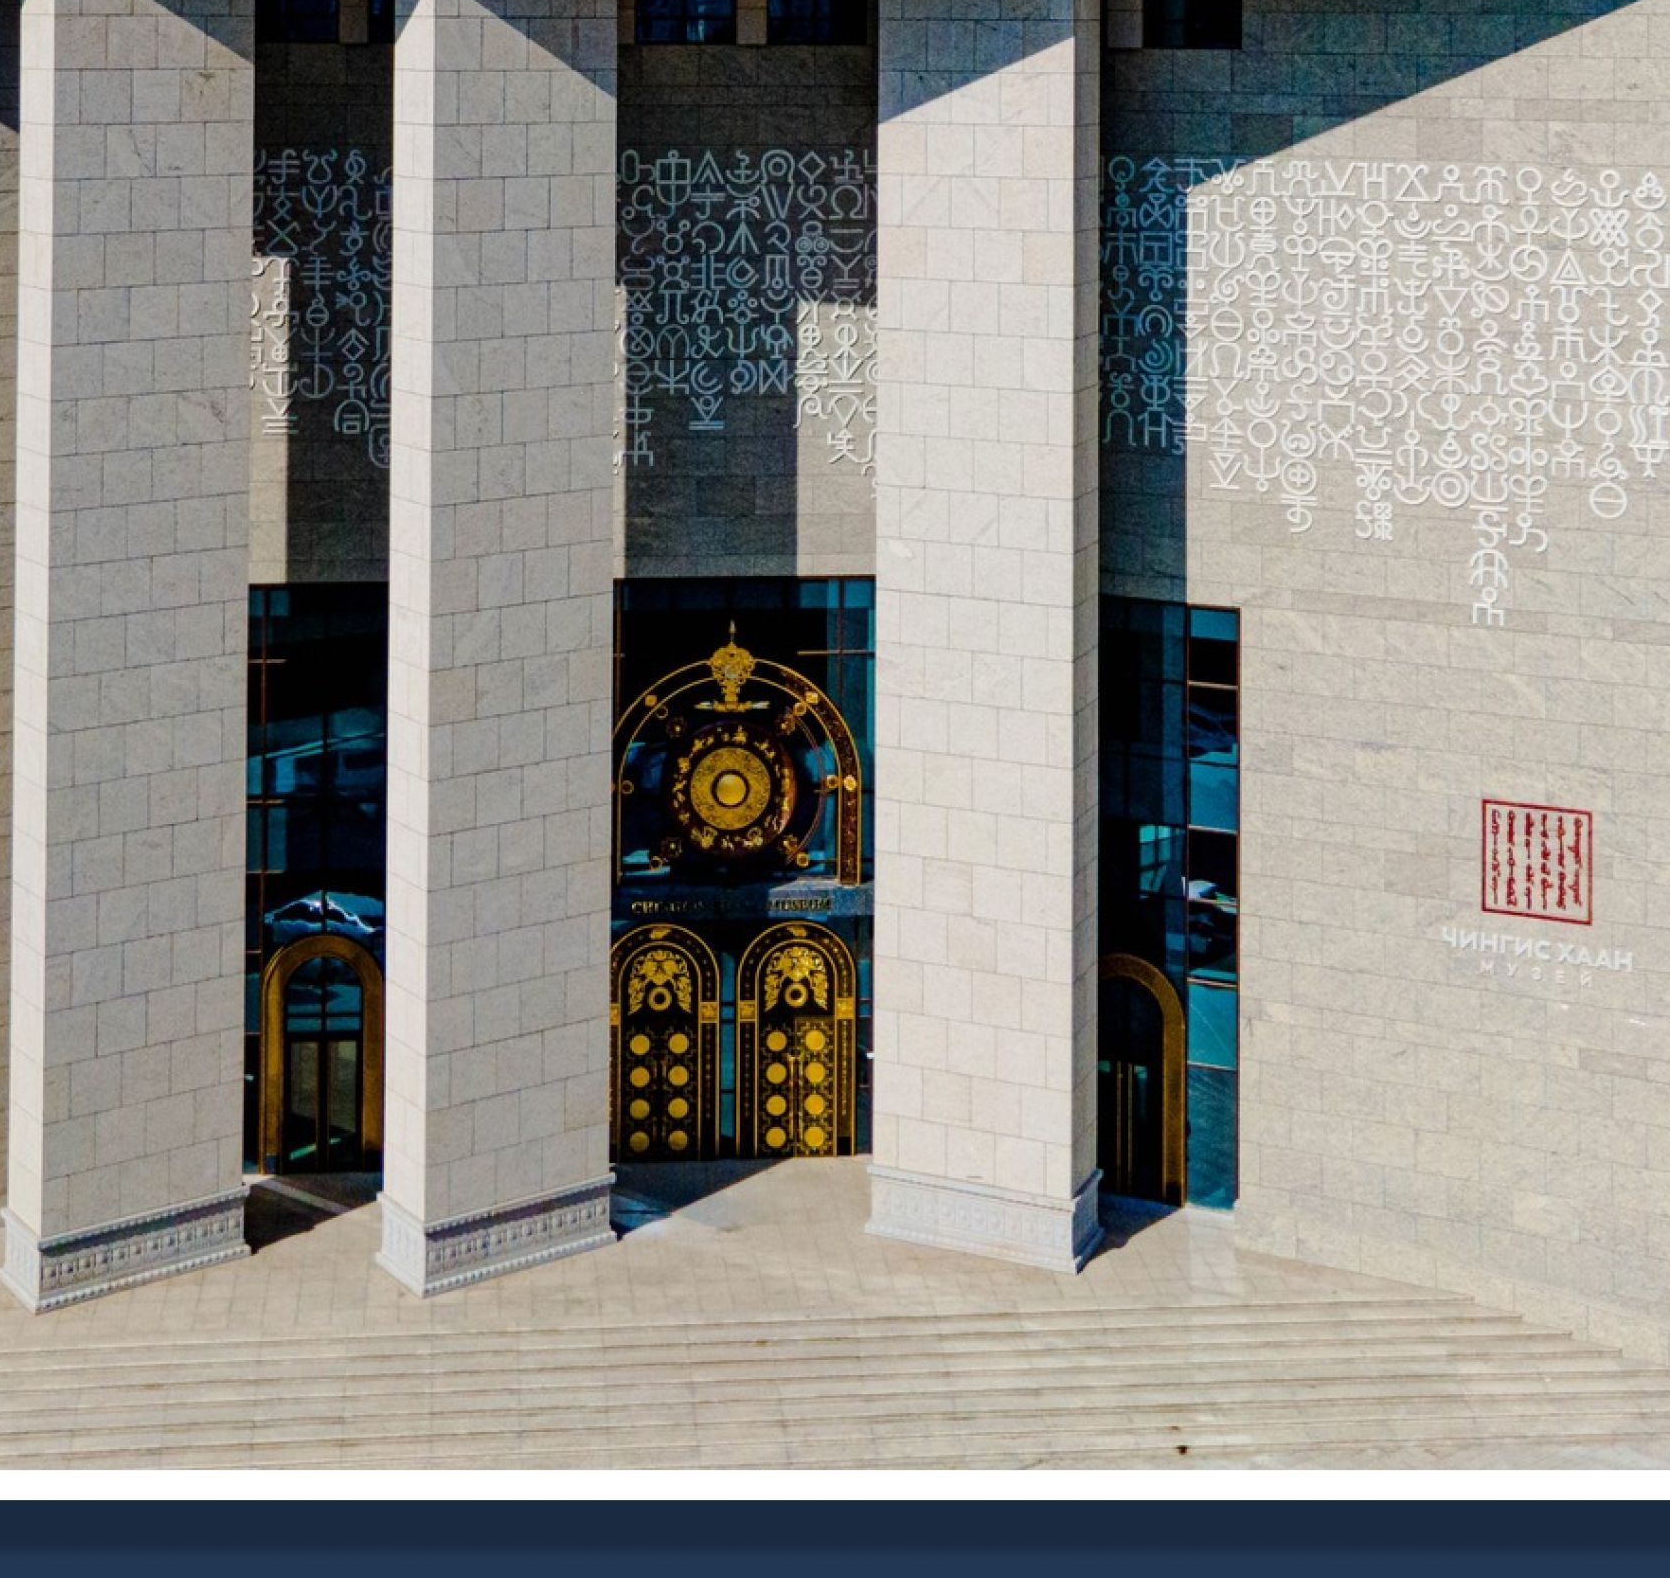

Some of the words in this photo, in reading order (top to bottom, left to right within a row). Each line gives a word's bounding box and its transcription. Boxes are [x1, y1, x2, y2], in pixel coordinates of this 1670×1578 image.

[1442, 925, 1551, 962] ЧИНГИС
[1557, 942, 1634, 973] ХААН
[1480, 958, 1592, 989] МУЗЕЙ
